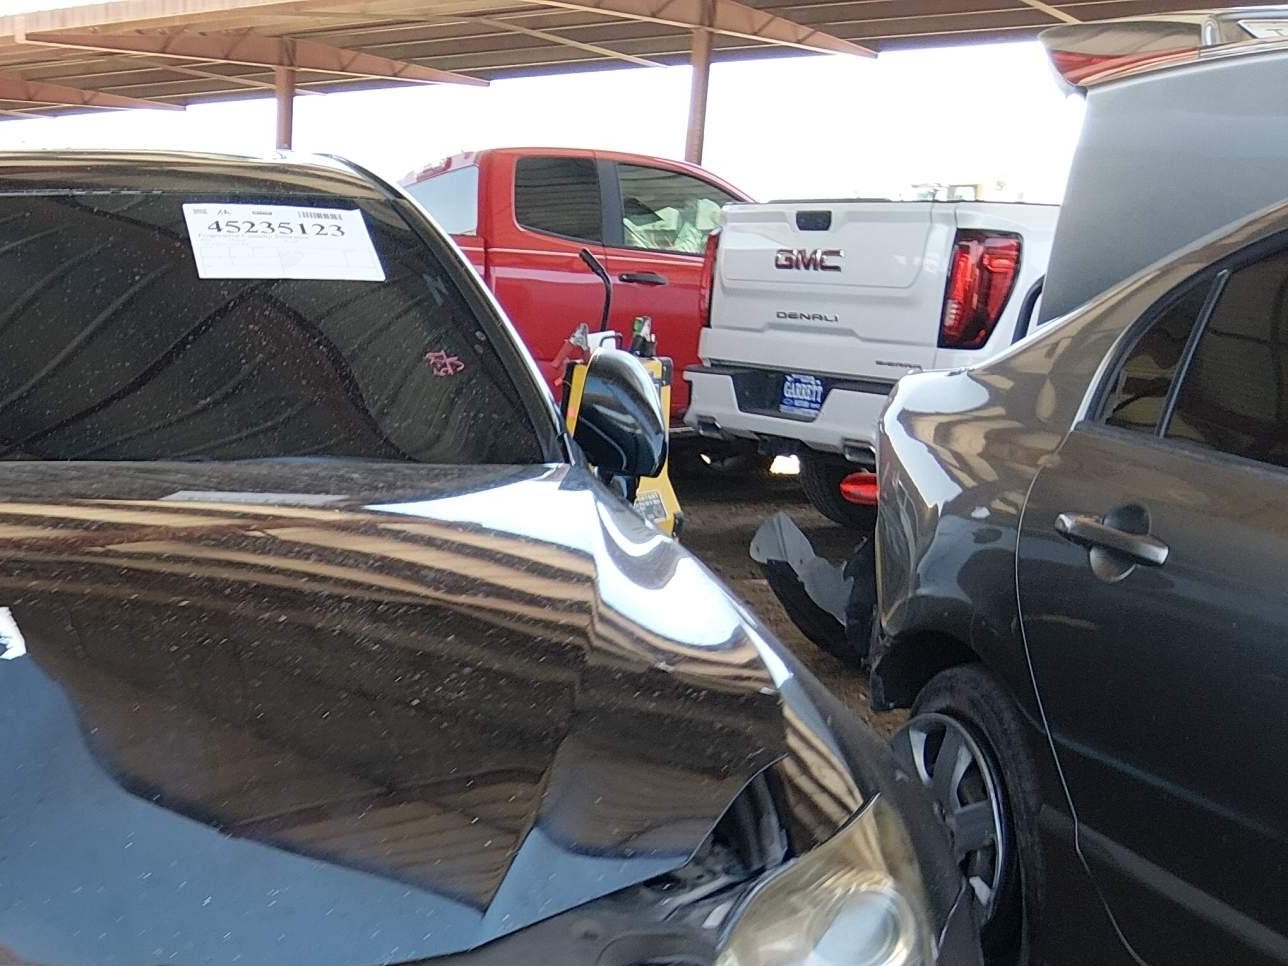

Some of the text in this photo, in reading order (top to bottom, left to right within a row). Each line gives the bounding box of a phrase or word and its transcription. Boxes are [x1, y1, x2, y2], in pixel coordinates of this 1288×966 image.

[207, 220, 345, 237] 45235123
[774, 248, 844, 272] GMC
[776, 311, 840, 323] DENALI
